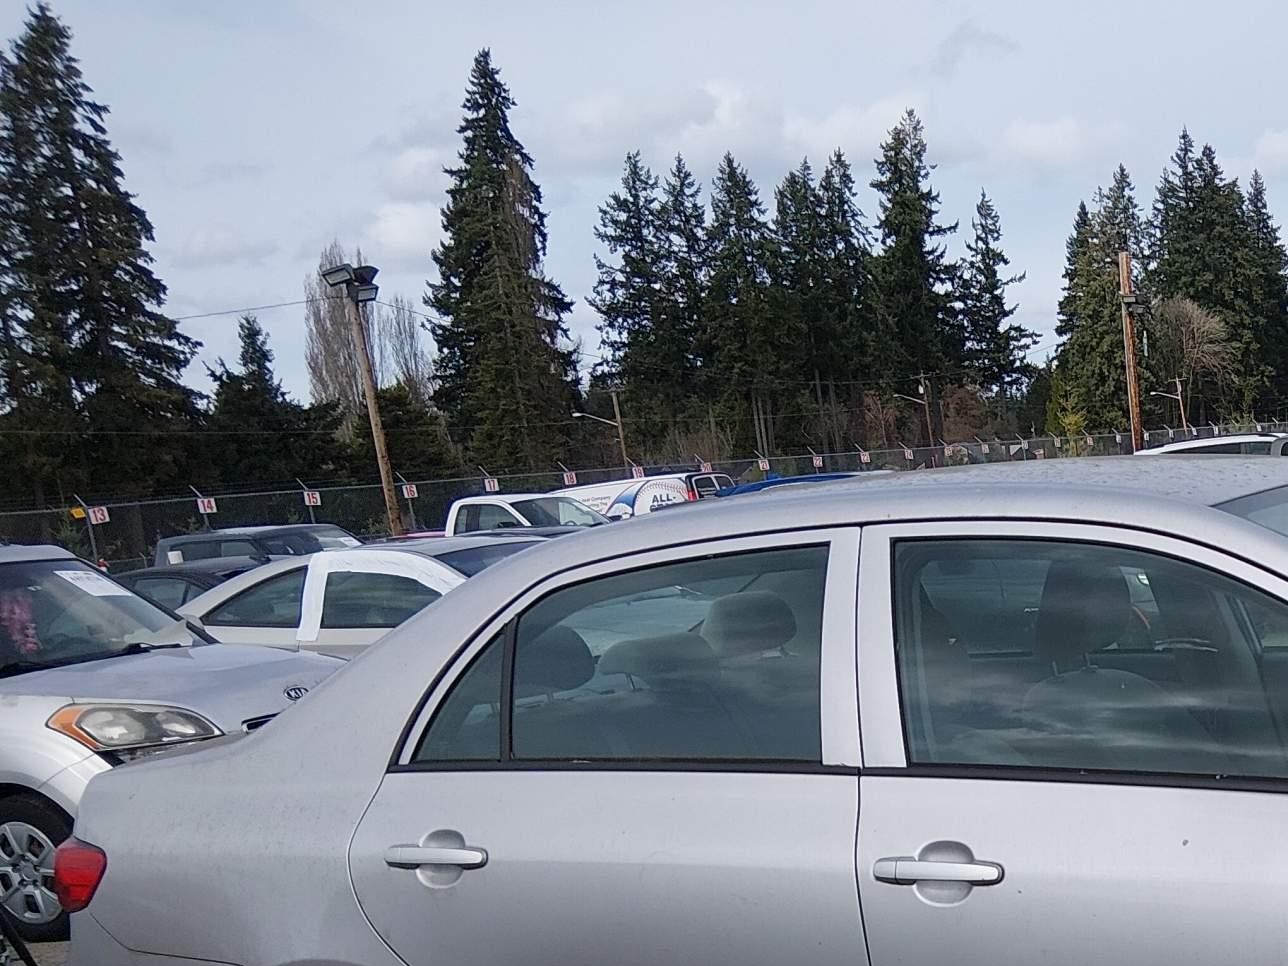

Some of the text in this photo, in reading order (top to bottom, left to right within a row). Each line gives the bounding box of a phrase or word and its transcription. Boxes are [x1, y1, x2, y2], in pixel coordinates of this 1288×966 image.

[634, 467, 643, 477] 19
[565, 474, 575, 484] 18
[405, 485, 416, 497] 16
[487, 480, 496, 491] 17
[306, 492, 318, 504] 15
[652, 494, 676, 503] ALL-
[200, 499, 214, 513] 14
[92, 507, 106, 522] 13
